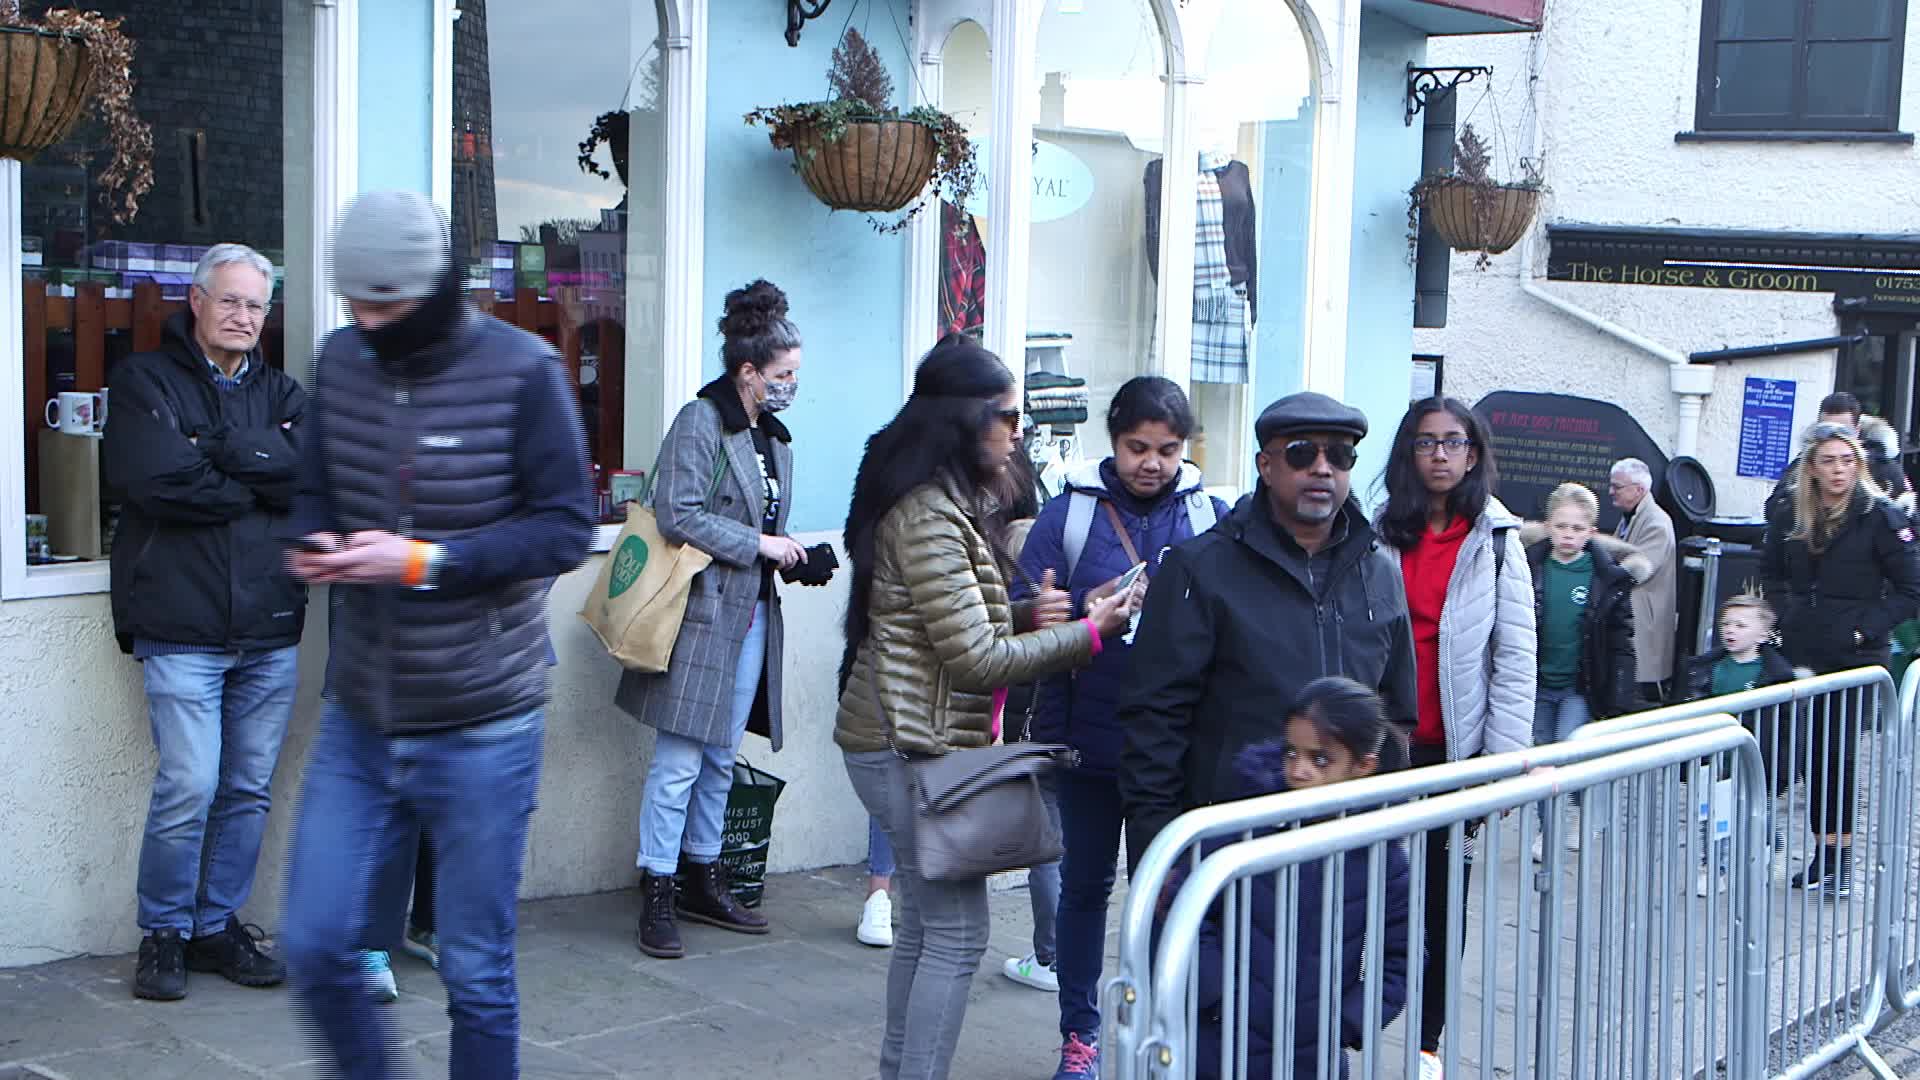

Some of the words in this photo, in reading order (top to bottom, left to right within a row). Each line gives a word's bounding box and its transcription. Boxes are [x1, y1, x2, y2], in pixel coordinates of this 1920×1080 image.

[1567, 261, 1613, 282] The
[1620, 264, 1695, 285] Horse
[1702, 268, 1720, 288] &
[1728, 269, 1818, 291] Groom
[724, 807, 744, 817] HIS
[735, 818, 762, 830] JUST
